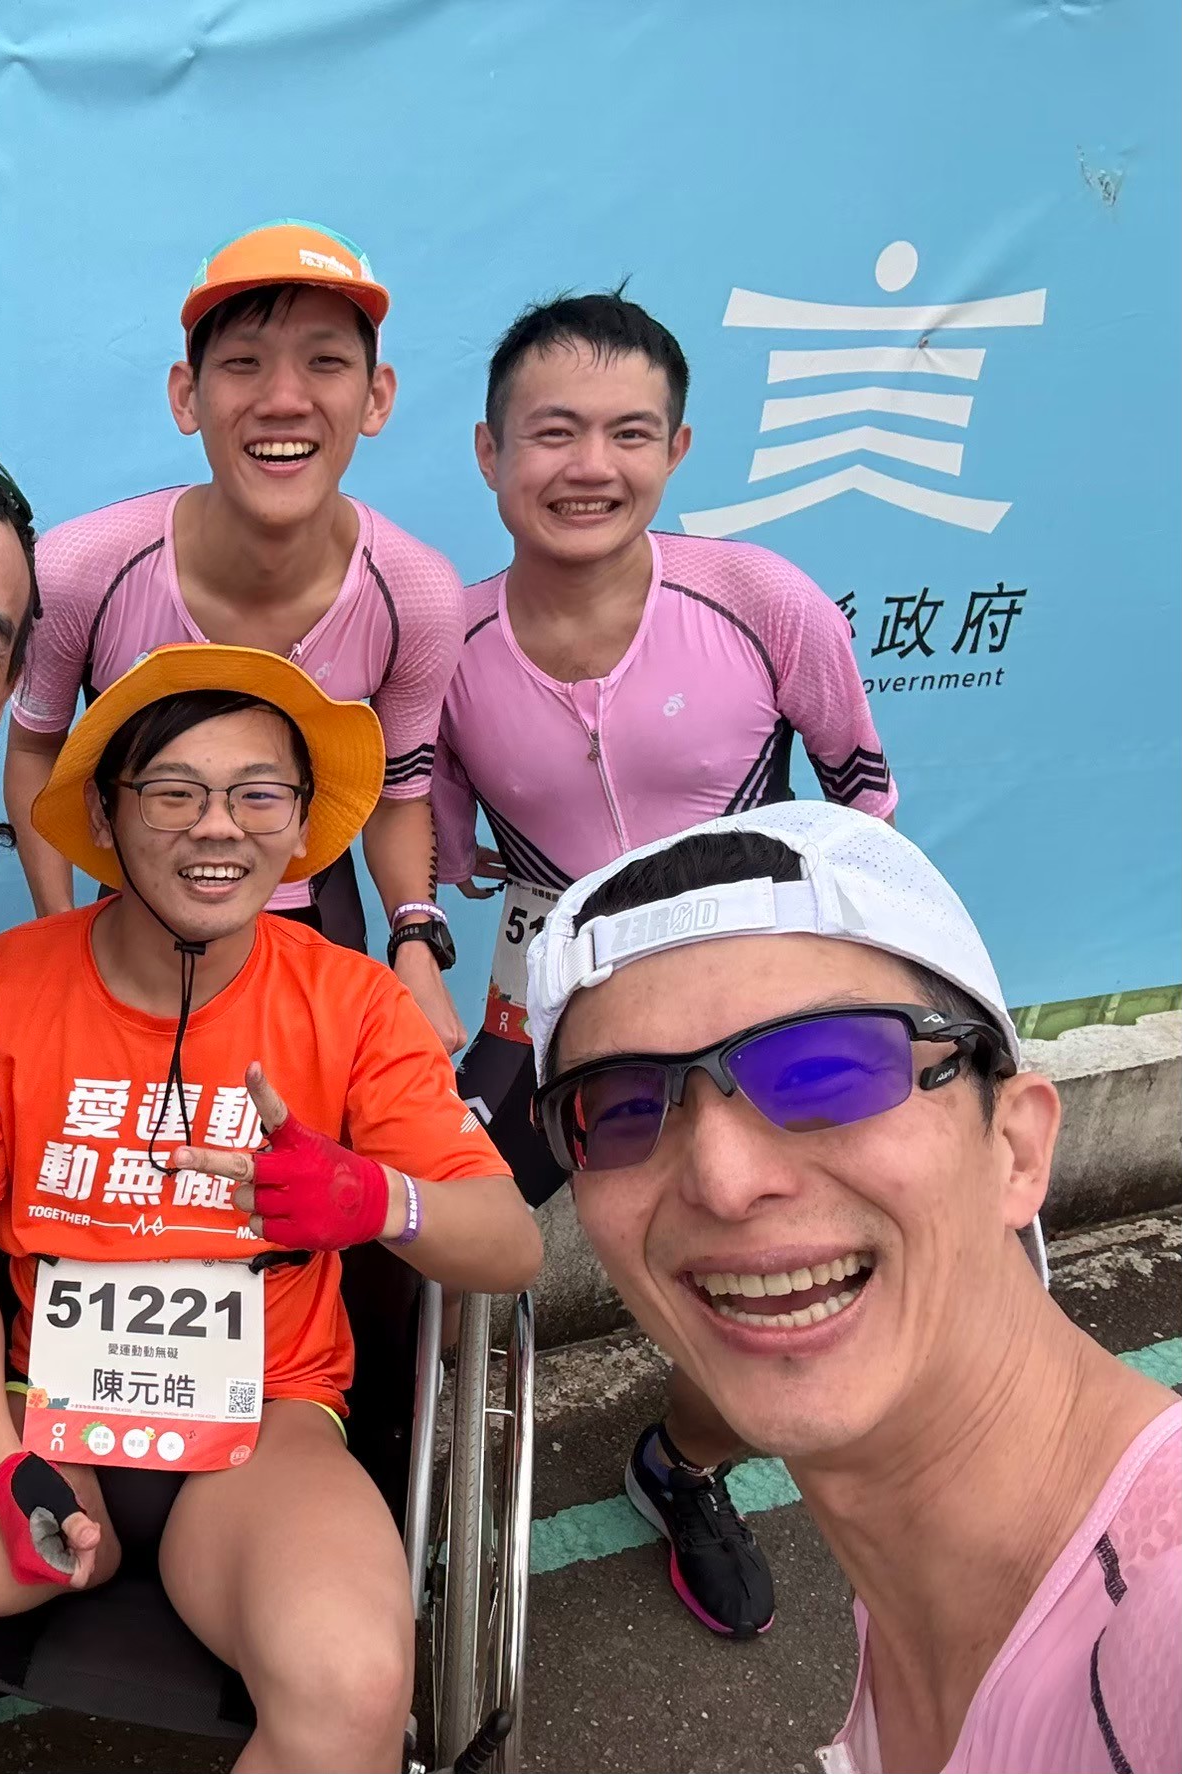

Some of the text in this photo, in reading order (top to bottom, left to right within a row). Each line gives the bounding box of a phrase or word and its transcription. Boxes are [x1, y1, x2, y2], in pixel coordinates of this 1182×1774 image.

[863, 667, 1006, 695] overnment
[61, 1077, 266, 1149] 愛運動
[27, 1204, 92, 1227] TOGETHER
[45, 1279, 242, 1340] 51221
[107, 1342, 179, 1360] 愛運動動無礙
[92, 1368, 196, 1409] 陳元皓
